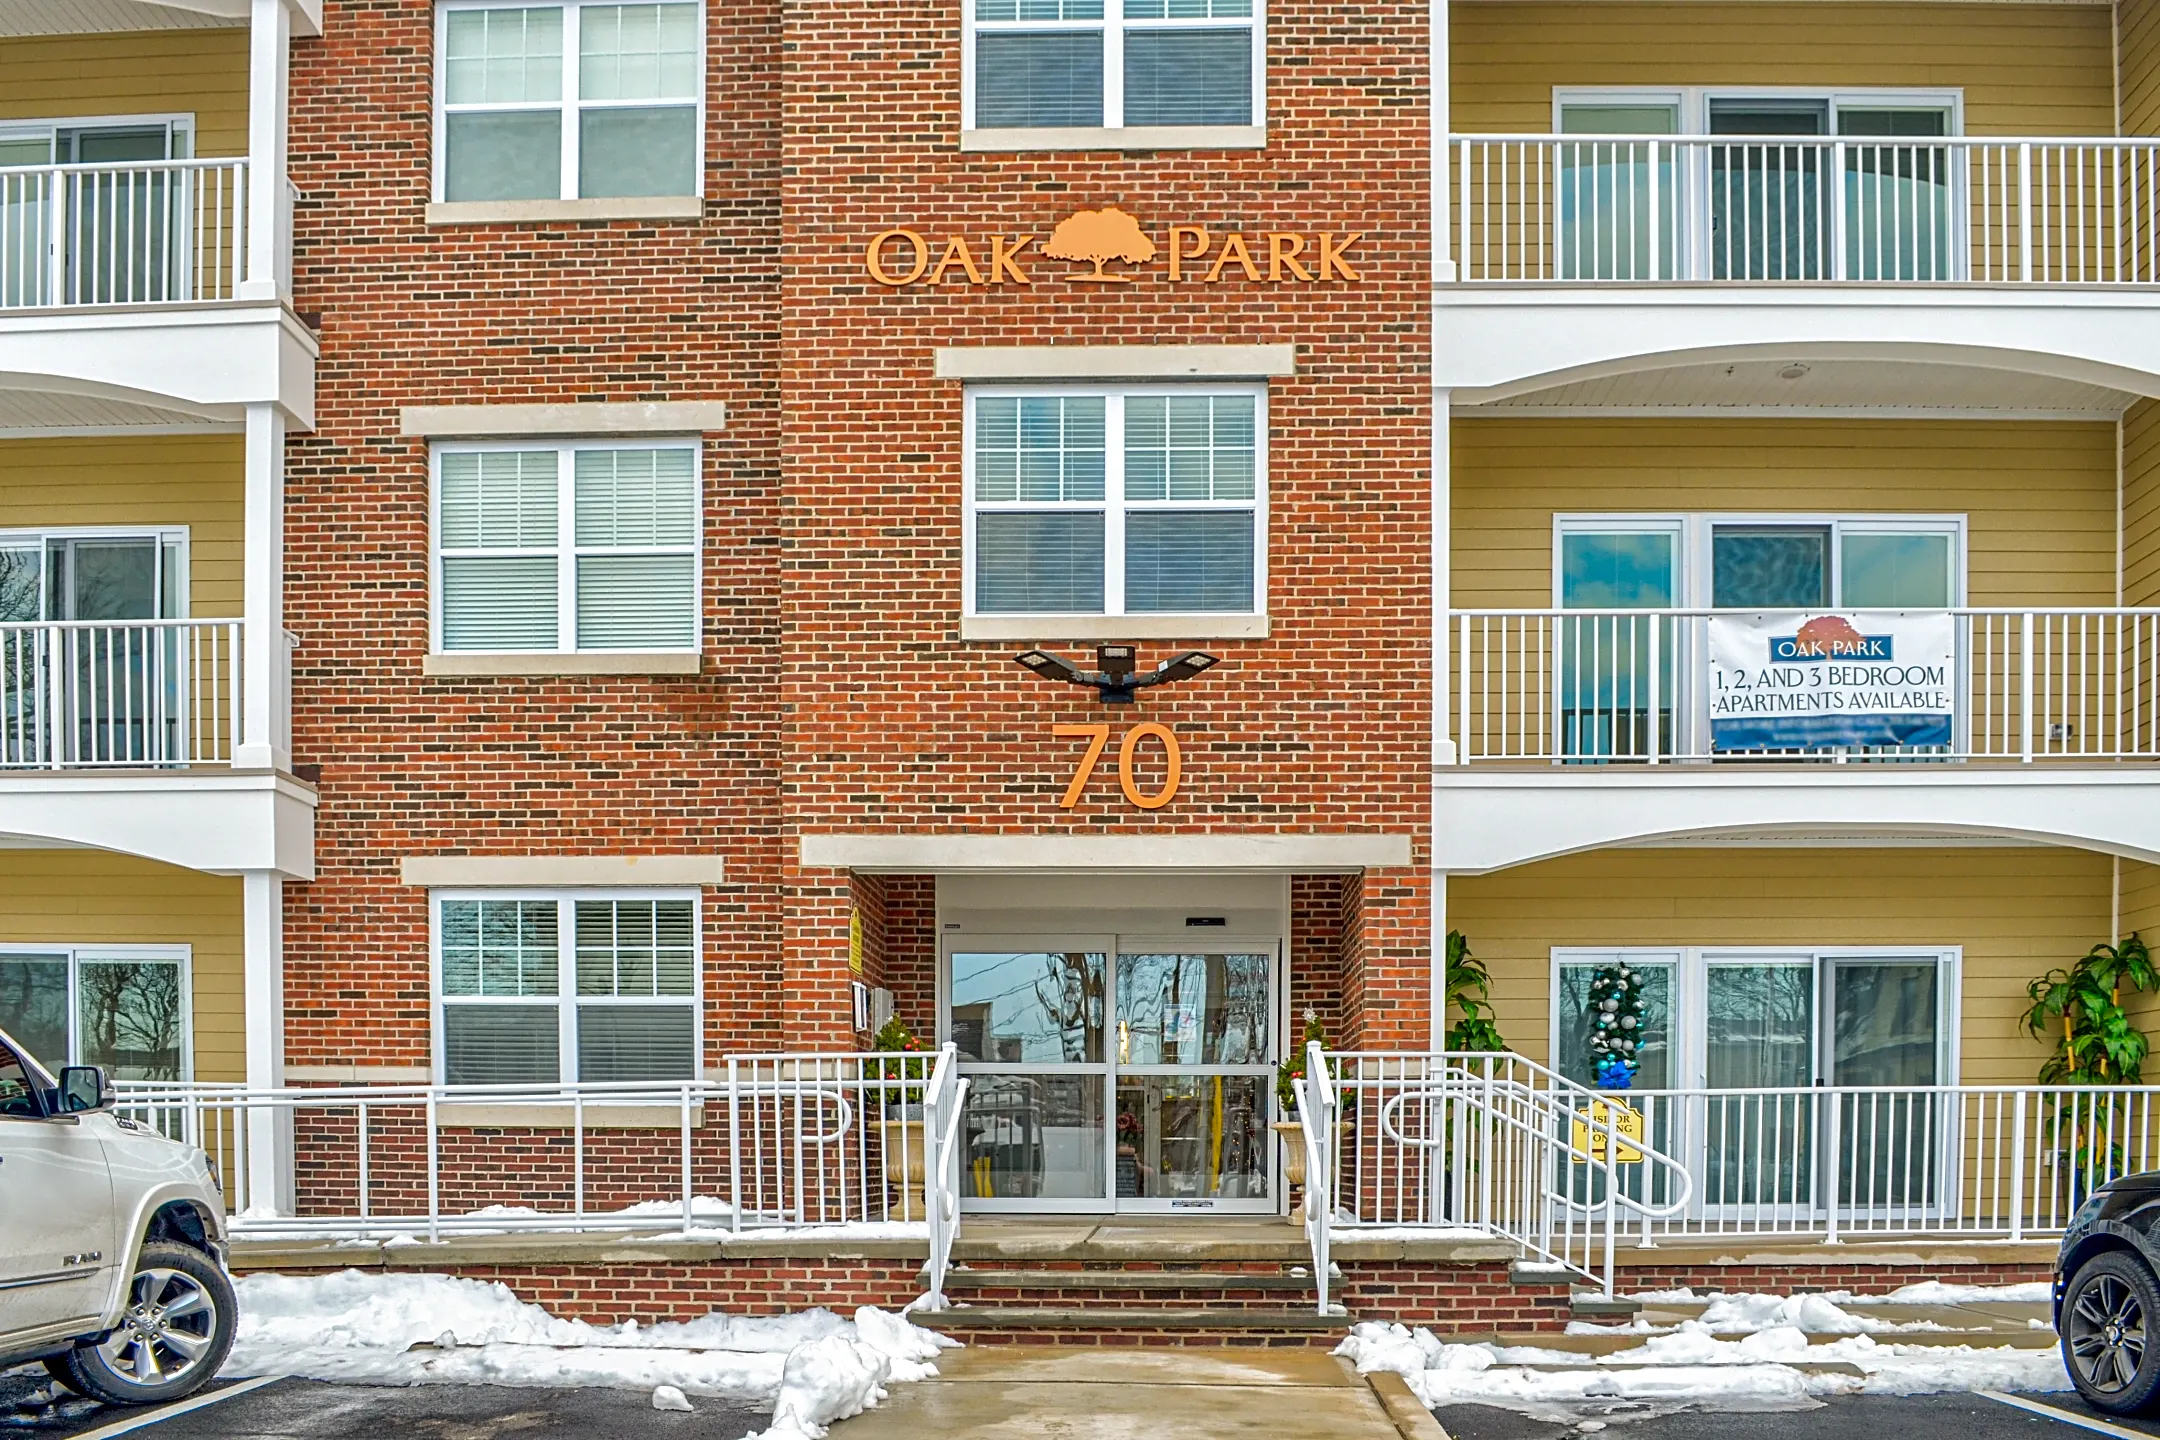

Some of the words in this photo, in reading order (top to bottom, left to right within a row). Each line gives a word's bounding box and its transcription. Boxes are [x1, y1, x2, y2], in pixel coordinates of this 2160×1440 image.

[866, 229, 1034, 286] OAK
[1168, 226, 1363, 283] PARK
[1778, 640, 1826, 657] OAK
[1833, 640, 1885, 656] PARK
[1716, 670, 1729, 693] 1,
[1733, 669, 1752, 692] 2,
[1756, 668, 1804, 688] AND
[1809, 667, 1822, 687] 3
[1828, 665, 1944, 687] BEDROOM
[1716, 692, 1844, 713] APARTMENTS
[1848, 691, 1946, 709] AVAILABLE
[1052, 723, 1182, 809] 70
